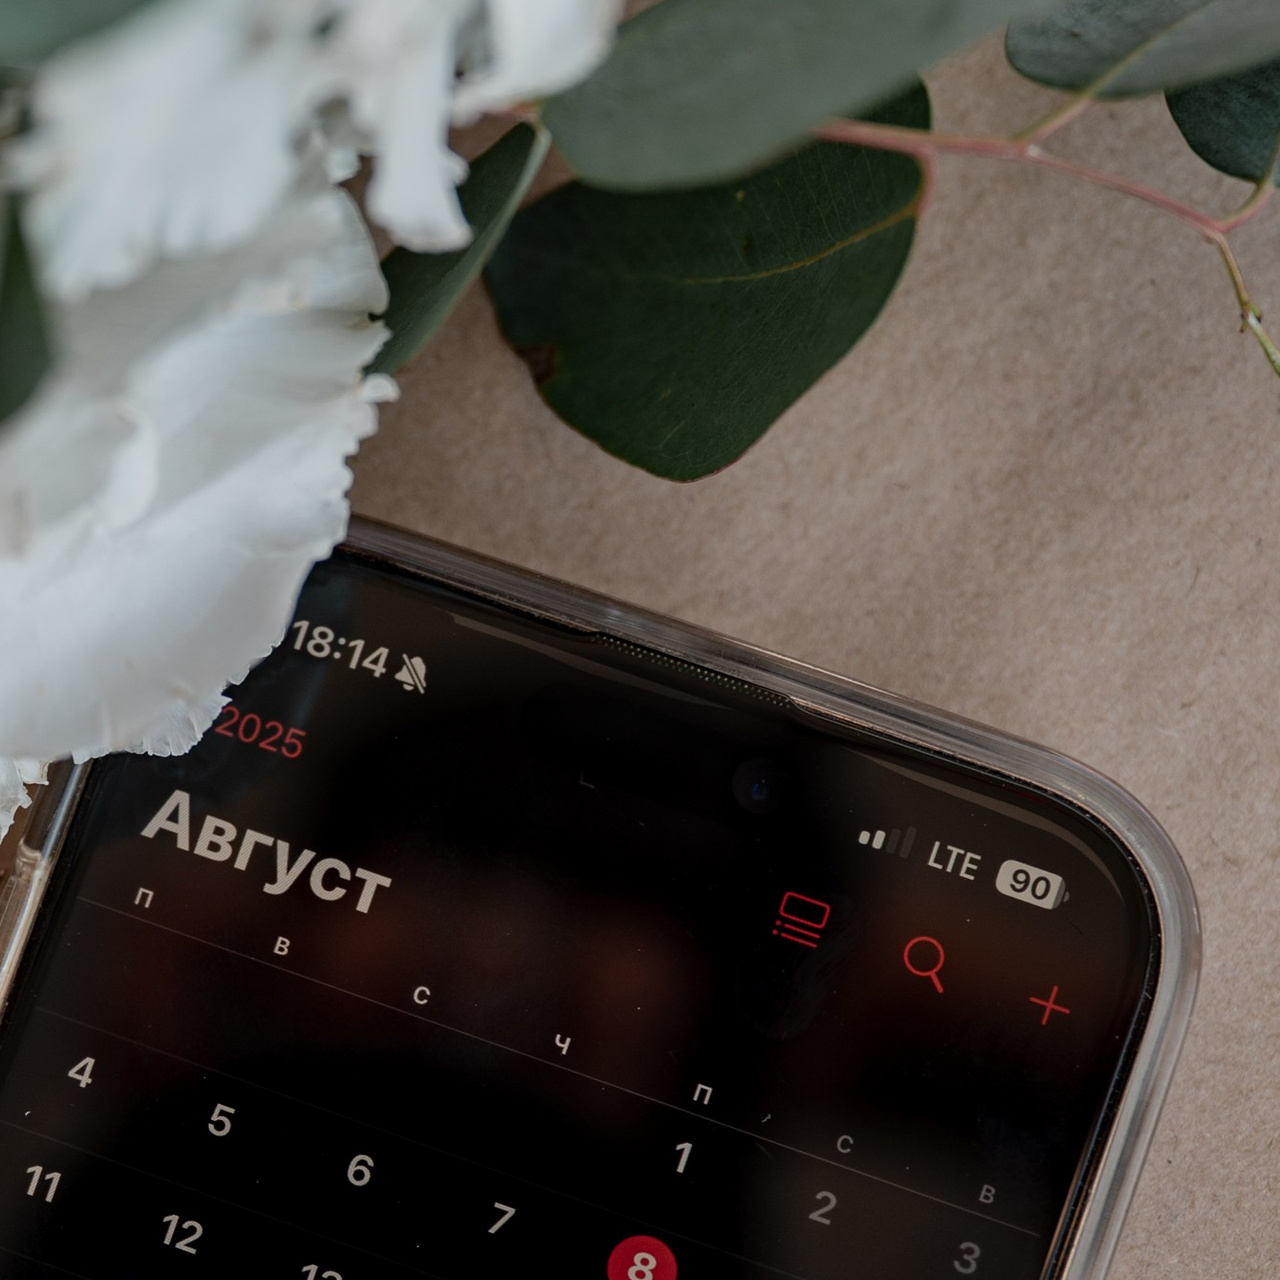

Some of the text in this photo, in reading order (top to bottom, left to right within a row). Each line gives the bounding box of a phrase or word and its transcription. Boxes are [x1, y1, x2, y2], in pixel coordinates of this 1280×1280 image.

[292, 619, 390, 678] 18:14
[214, 705, 307, 759] 2025
[140, 789, 392, 914] Август
[928, 841, 981, 880] LTE
[1008, 868, 1052, 902] 90
[68, 1057, 95, 1088] 4
[208, 1104, 235, 1136] 5
[347, 1155, 374, 1186] 6
[489, 1202, 515, 1233] 7
[27, 1165, 61, 1202] 11
[163, 1215, 203, 1254] 12
[676, 1142, 980, 1274] 1 2 3
